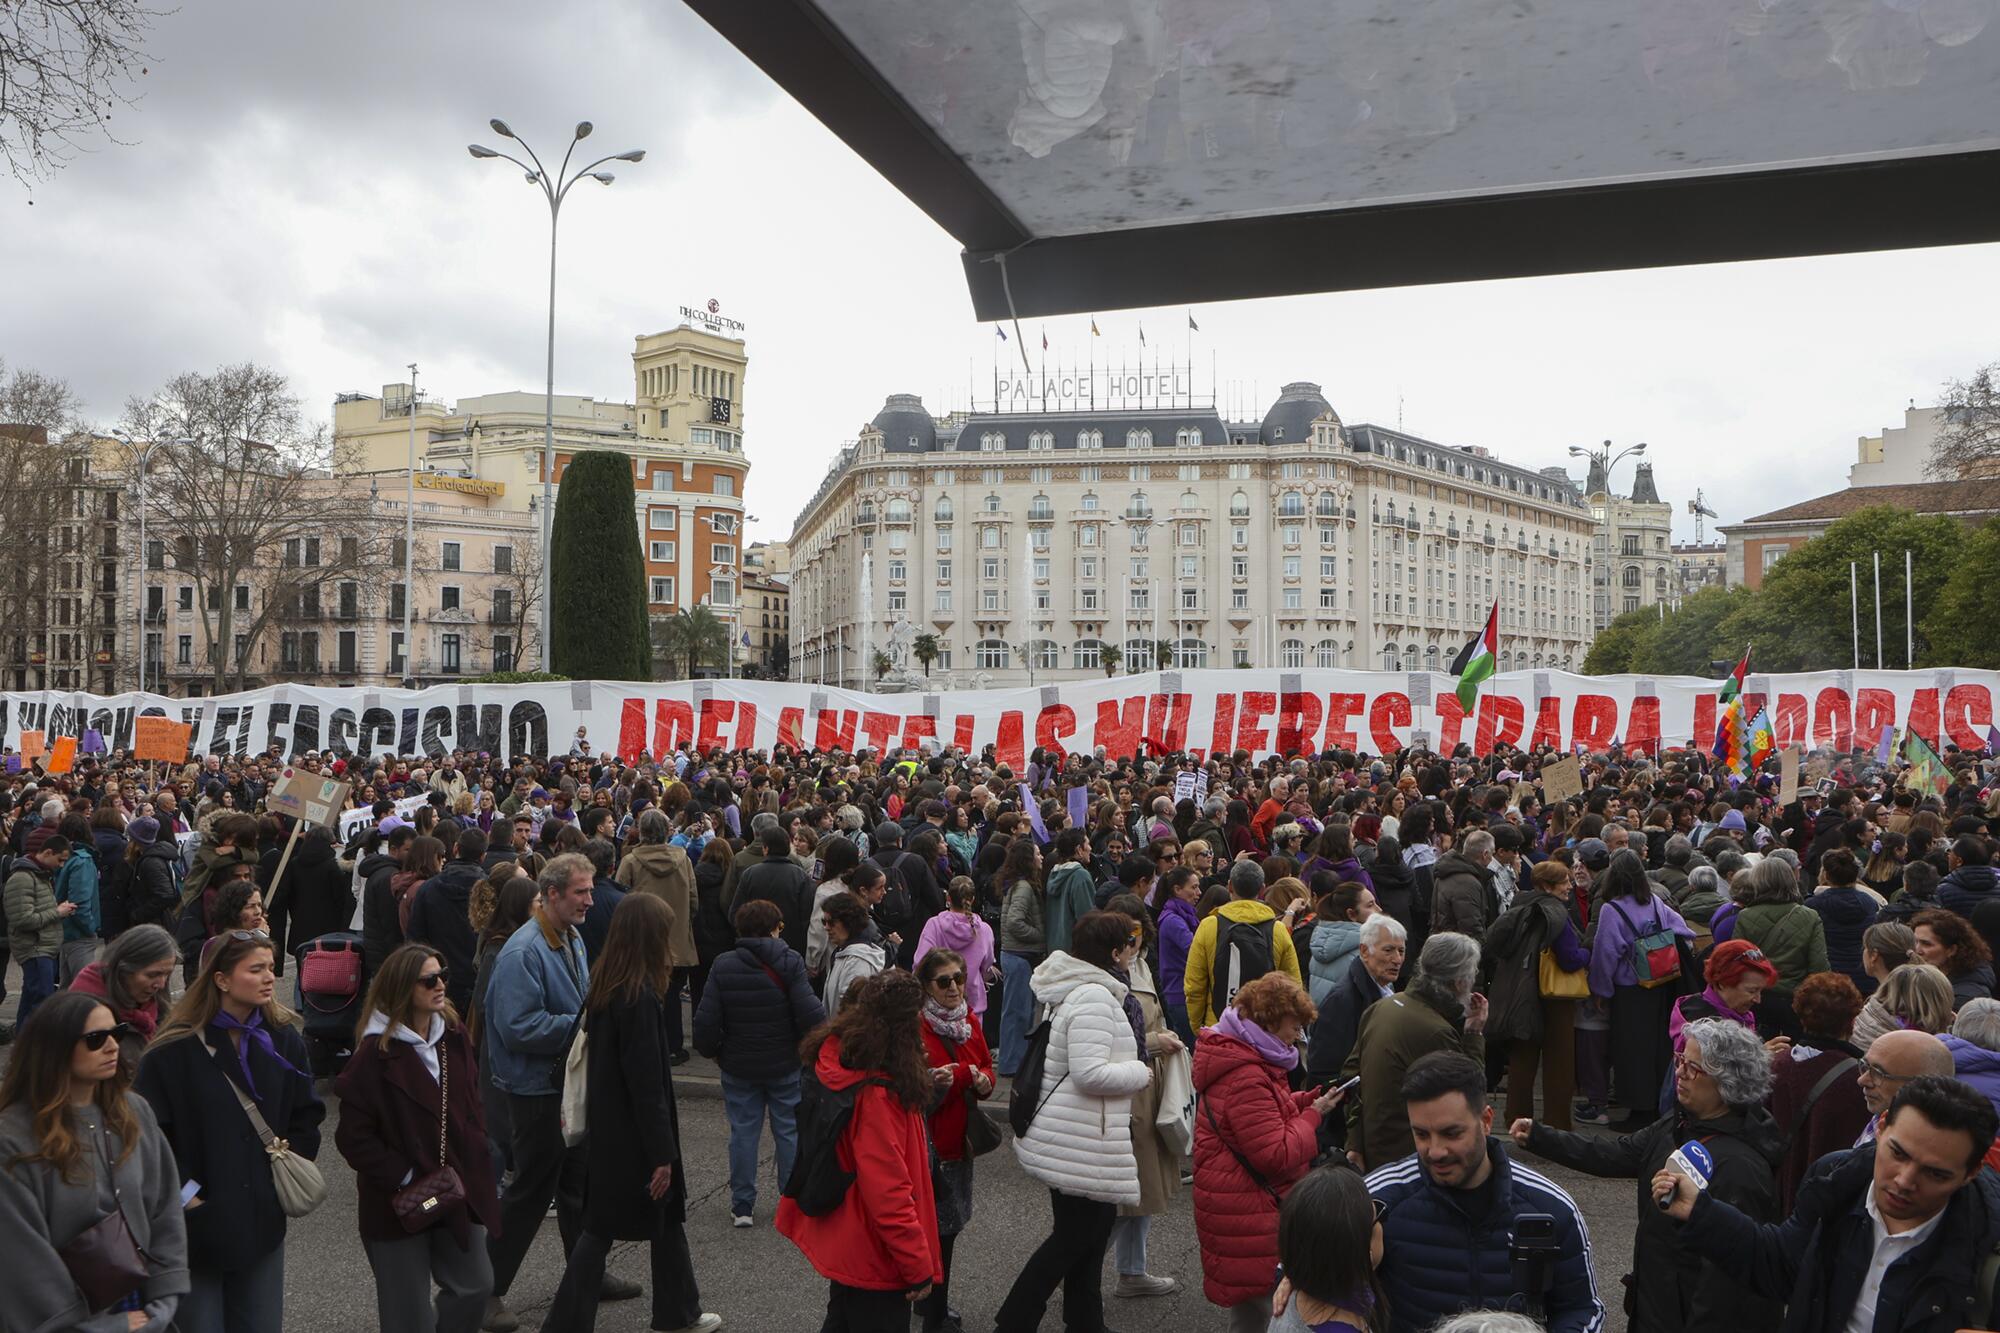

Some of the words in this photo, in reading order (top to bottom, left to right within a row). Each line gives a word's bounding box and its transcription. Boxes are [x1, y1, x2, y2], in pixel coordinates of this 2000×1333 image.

[692, 309, 745, 331] COLLECTION
[999, 378, 1090, 400] PALACE
[1110, 375, 1188, 397] HOTEL
[434, 477, 498, 495] Fraternidad
[267, 700, 549, 760] FASCISMO
[1093, 691, 1412, 761] MUJERES
[1679, 1157, 1704, 1186] CNN
[1691, 1146, 1712, 1173] CNN
